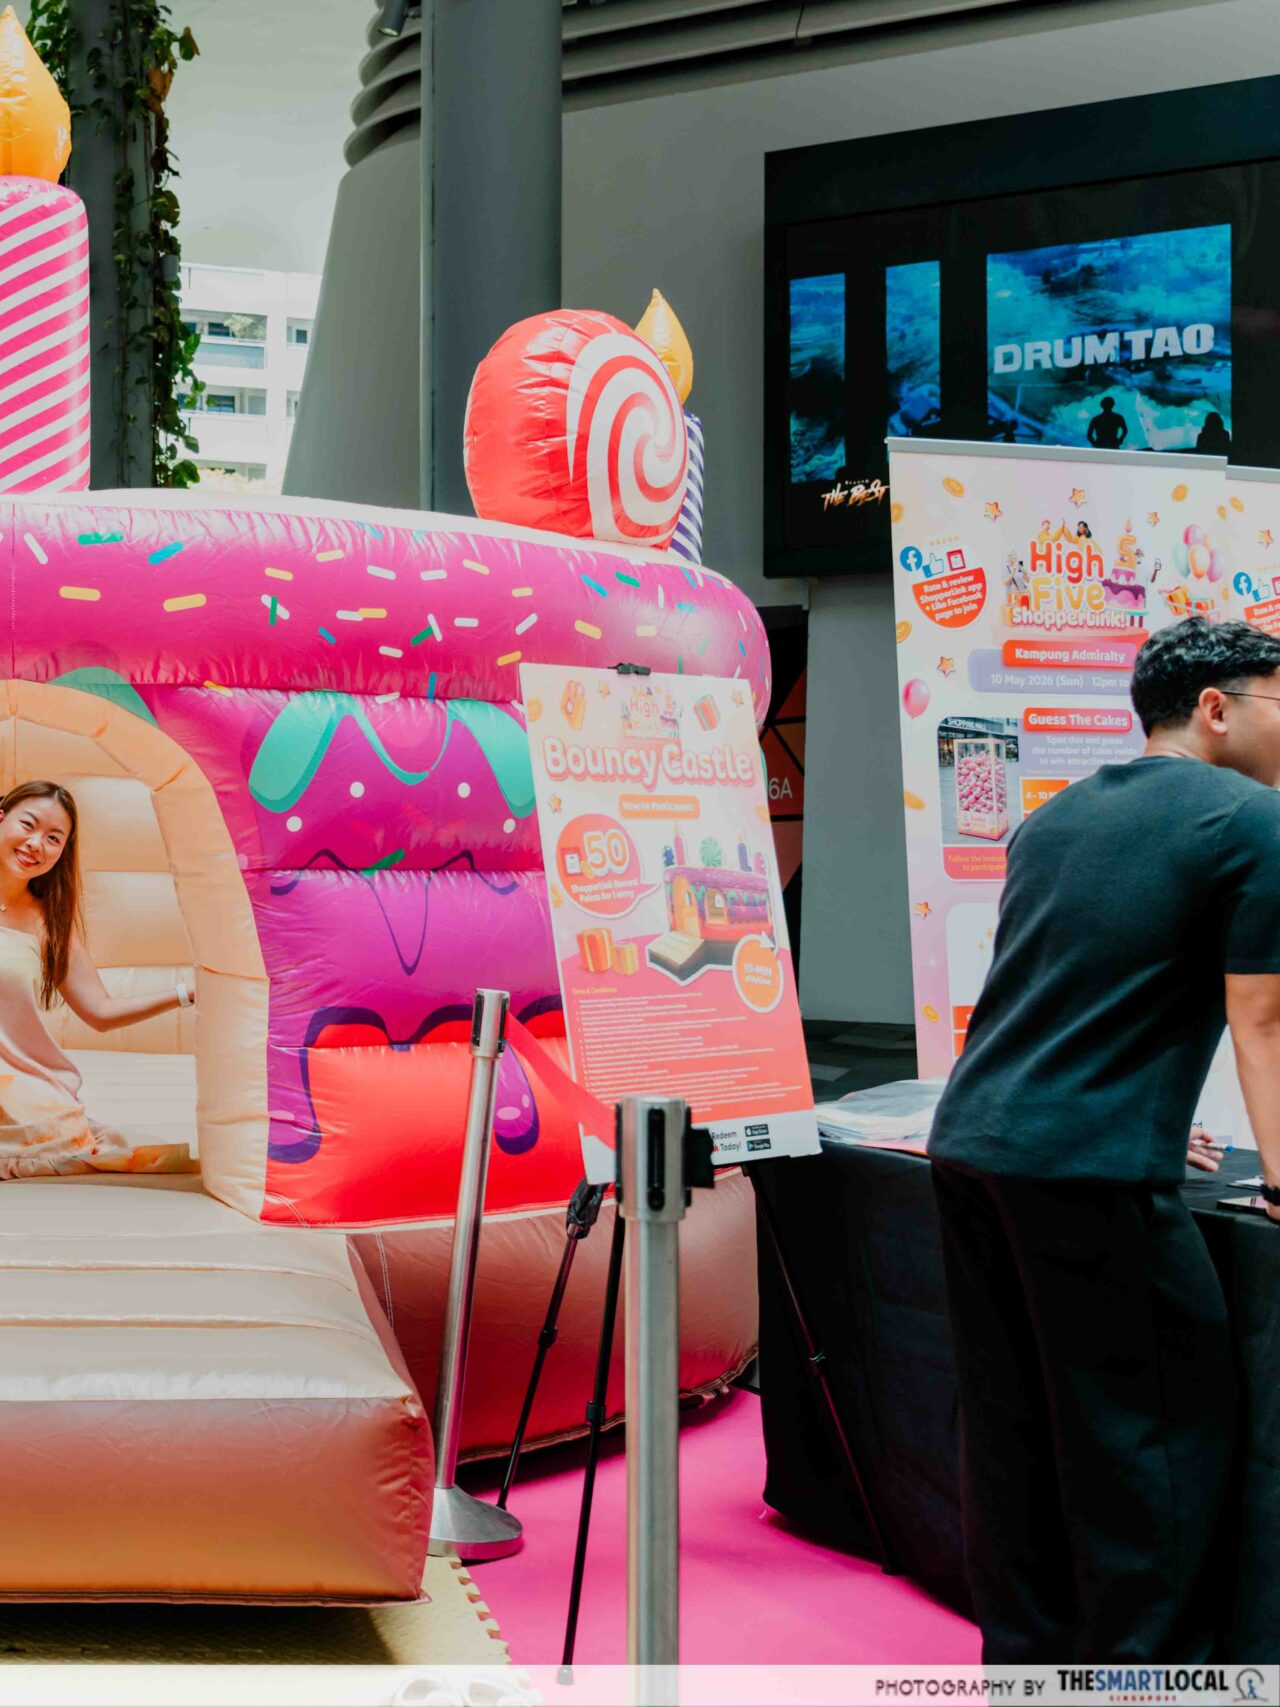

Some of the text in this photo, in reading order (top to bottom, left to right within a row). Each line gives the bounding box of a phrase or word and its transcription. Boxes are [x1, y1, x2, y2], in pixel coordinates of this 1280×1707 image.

[994, 323, 1215, 374] DRUM TAO
[1030, 540, 1104, 584] High
[947, 592, 982, 606] Facebook
[1032, 577, 1105, 611] Five
[1015, 648, 1125, 663] Kampung Admiralty
[991, 674, 1001, 685] 10
[1005, 675, 1025, 687] May
[1028, 675, 1053, 686] 2026
[1056, 674, 1084, 688] (Sun)
[1092, 676, 1117, 688] 12pm
[1029, 713, 1128, 726] Guess The Cakes
[544, 737, 754, 790] Bouncy Castle
[585, 830, 629, 875] 50
[711, 1131, 737, 1140] Redeem
